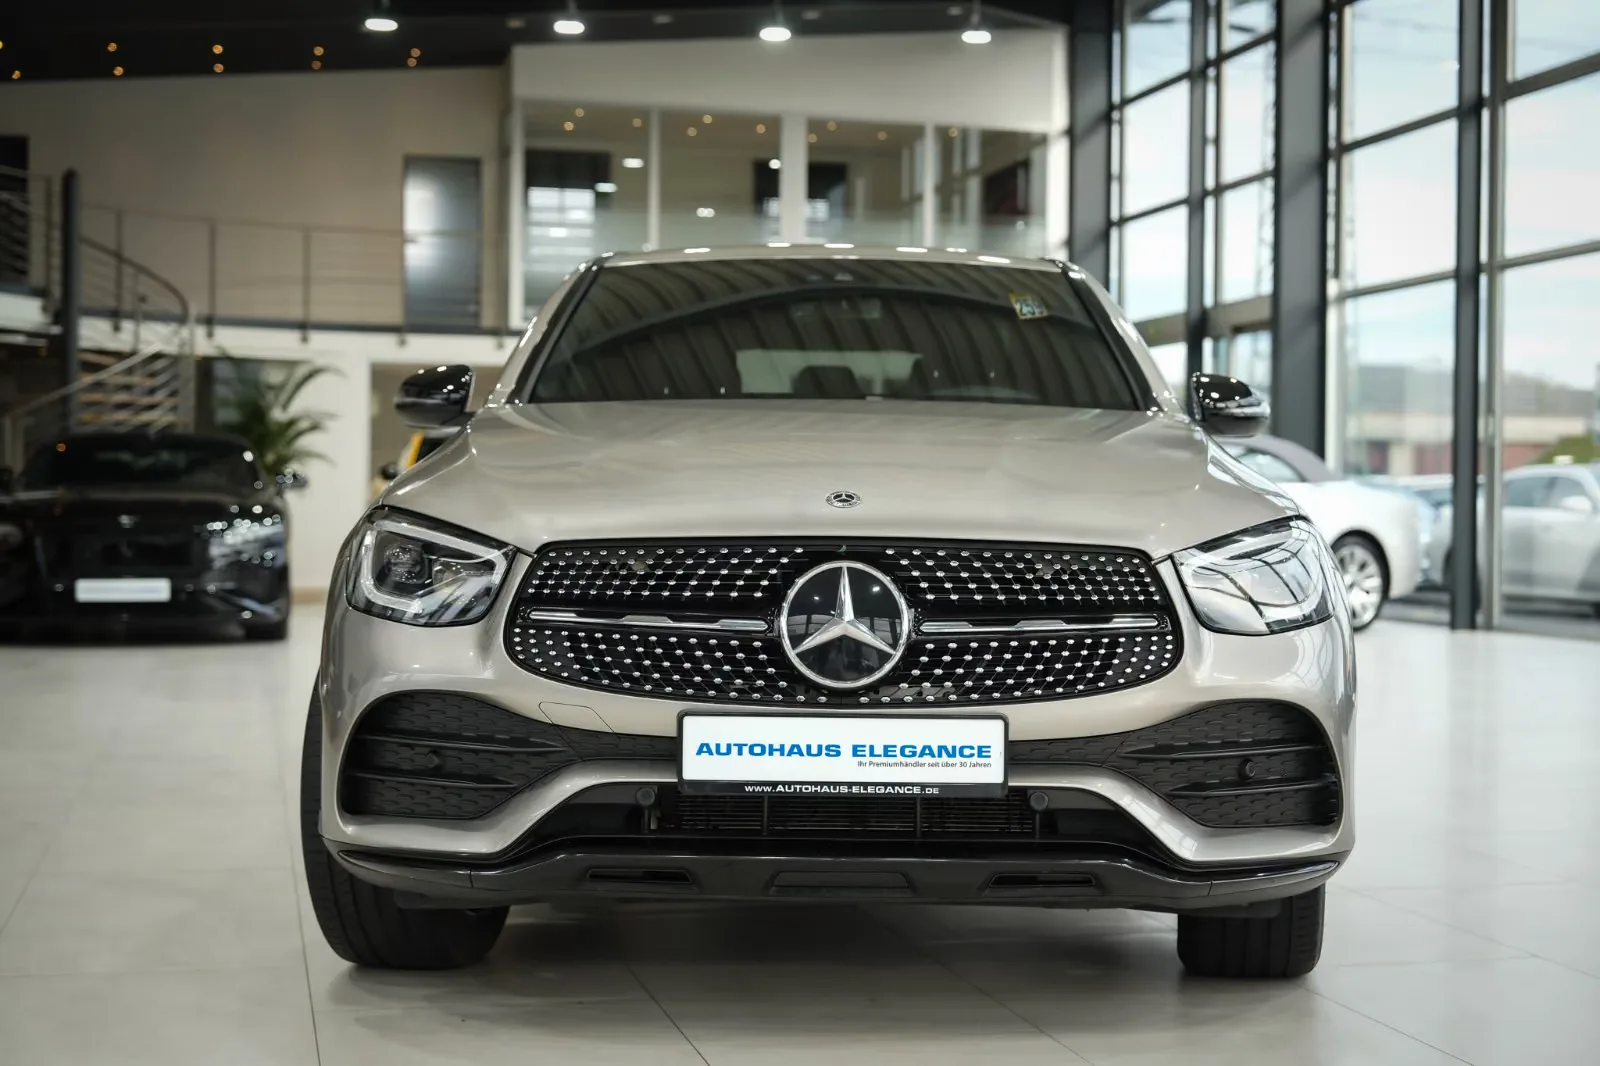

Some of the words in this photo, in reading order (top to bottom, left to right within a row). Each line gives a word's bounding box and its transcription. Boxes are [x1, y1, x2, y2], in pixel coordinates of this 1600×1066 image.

[696, 743, 841, 757] AUTOHAUS
[852, 744, 992, 758] ELEGANCE
[869, 760, 926, 768] Premiumhändler
